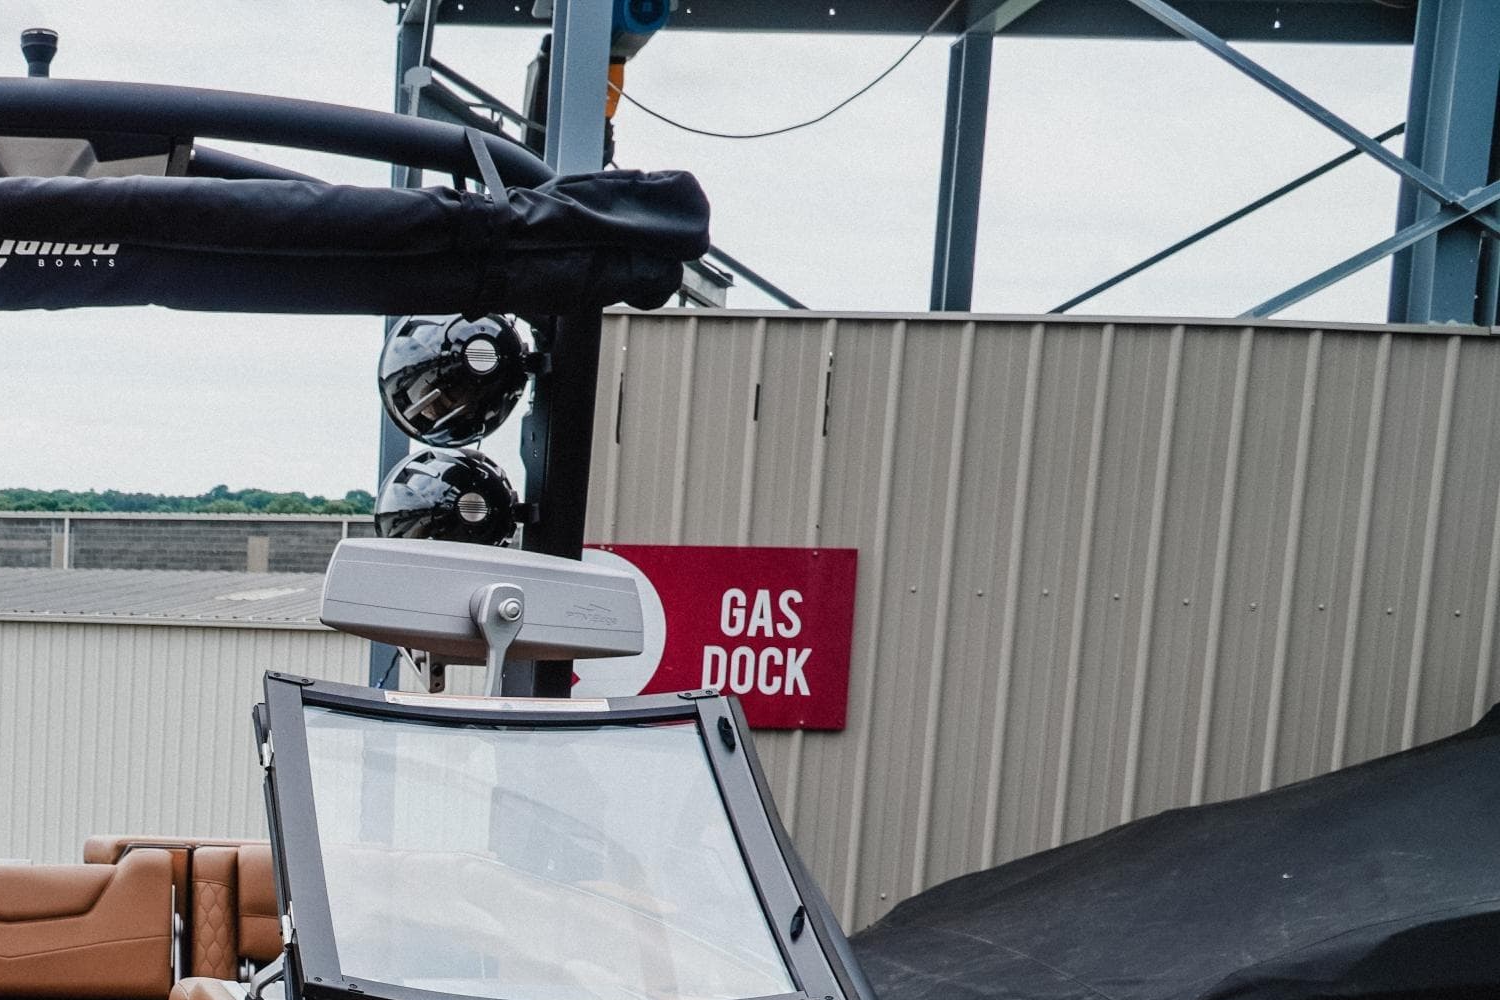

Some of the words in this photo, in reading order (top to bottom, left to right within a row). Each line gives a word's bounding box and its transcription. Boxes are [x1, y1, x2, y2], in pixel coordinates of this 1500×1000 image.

[38, 258, 115, 268] BOATS
[720, 588, 804, 639] GAS
[701, 645, 813, 697] DOCK
